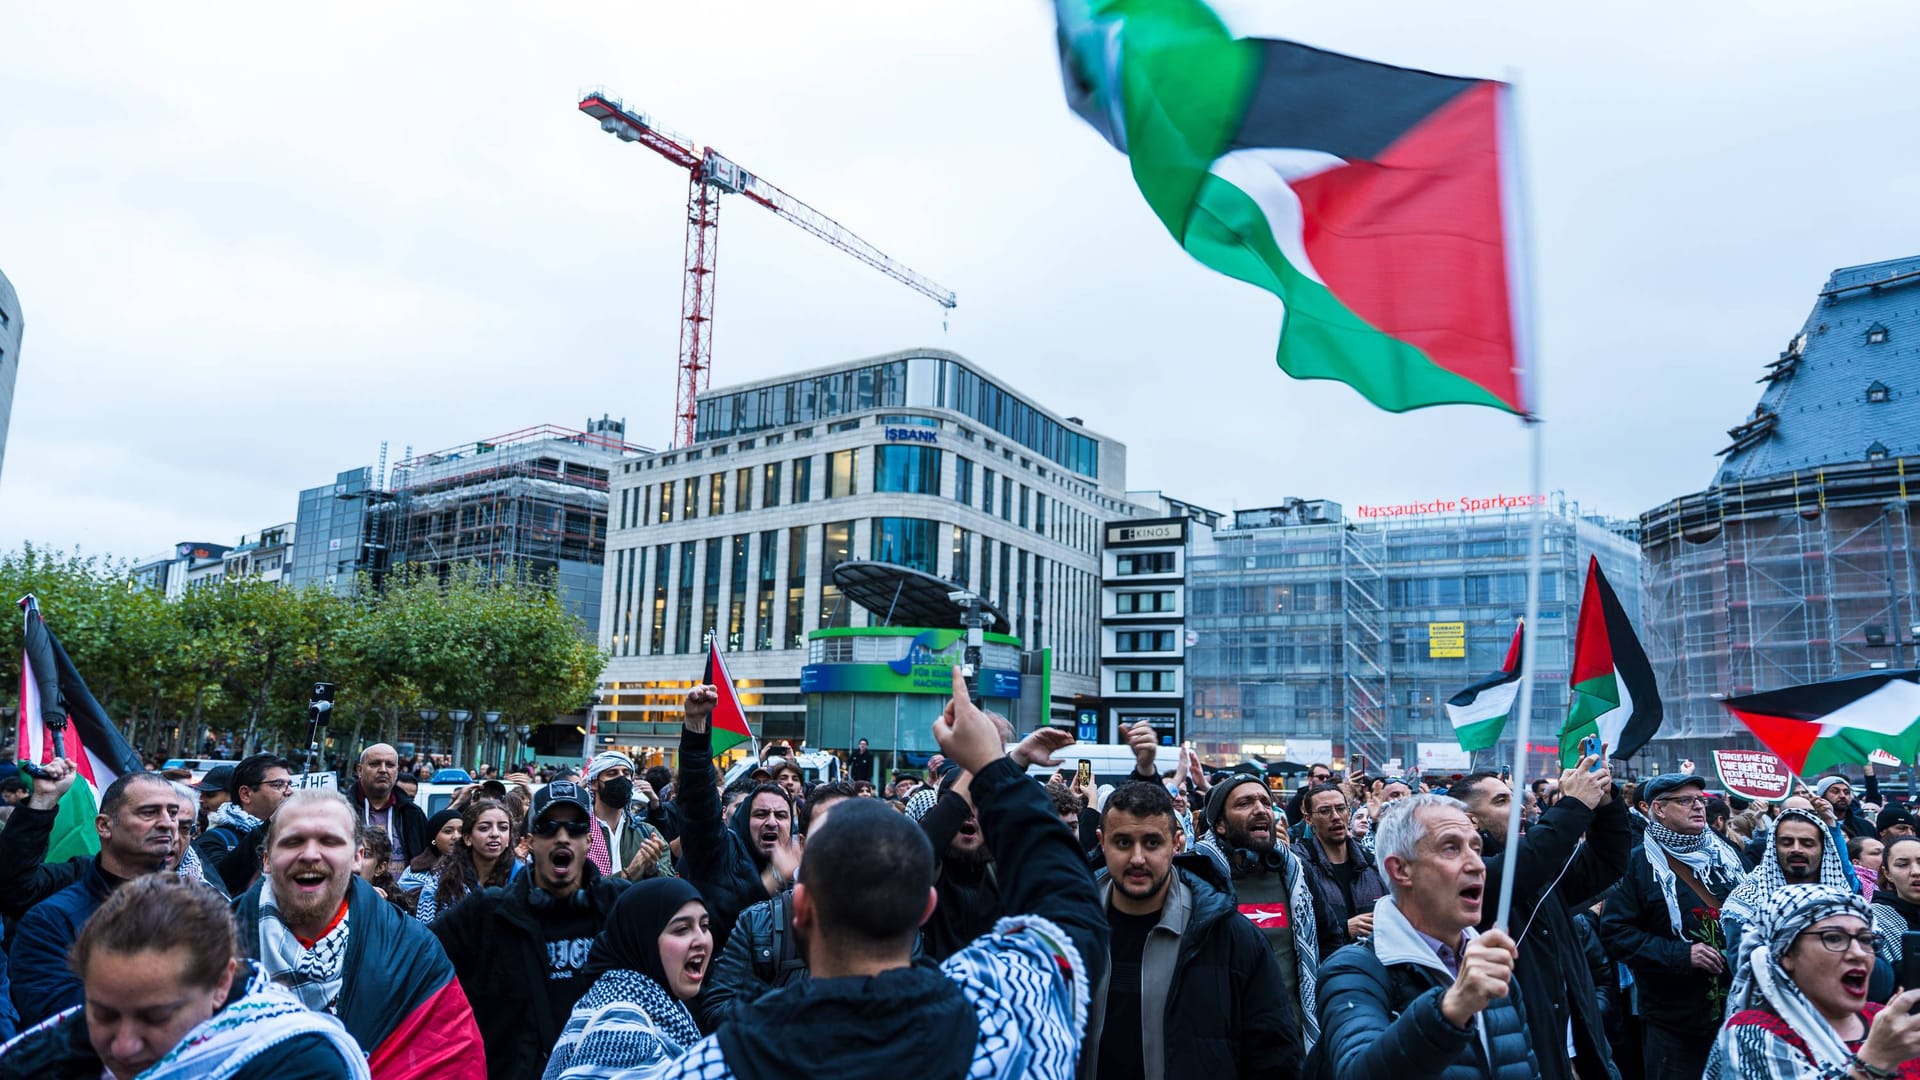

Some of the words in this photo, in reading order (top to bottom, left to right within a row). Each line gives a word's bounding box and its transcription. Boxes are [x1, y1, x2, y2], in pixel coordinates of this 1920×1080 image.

[1358, 499, 1456, 518] Nassauische
[1460, 493, 1546, 512] Sparkasse
[1136, 527, 1170, 538] KINOS
[1080, 713, 1089, 724] S
[1079, 727, 1090, 740] U
[1761, 755, 1778, 765] ONLY
[1721, 760, 1738, 770] ONE
[1761, 763, 1775, 773] TO
